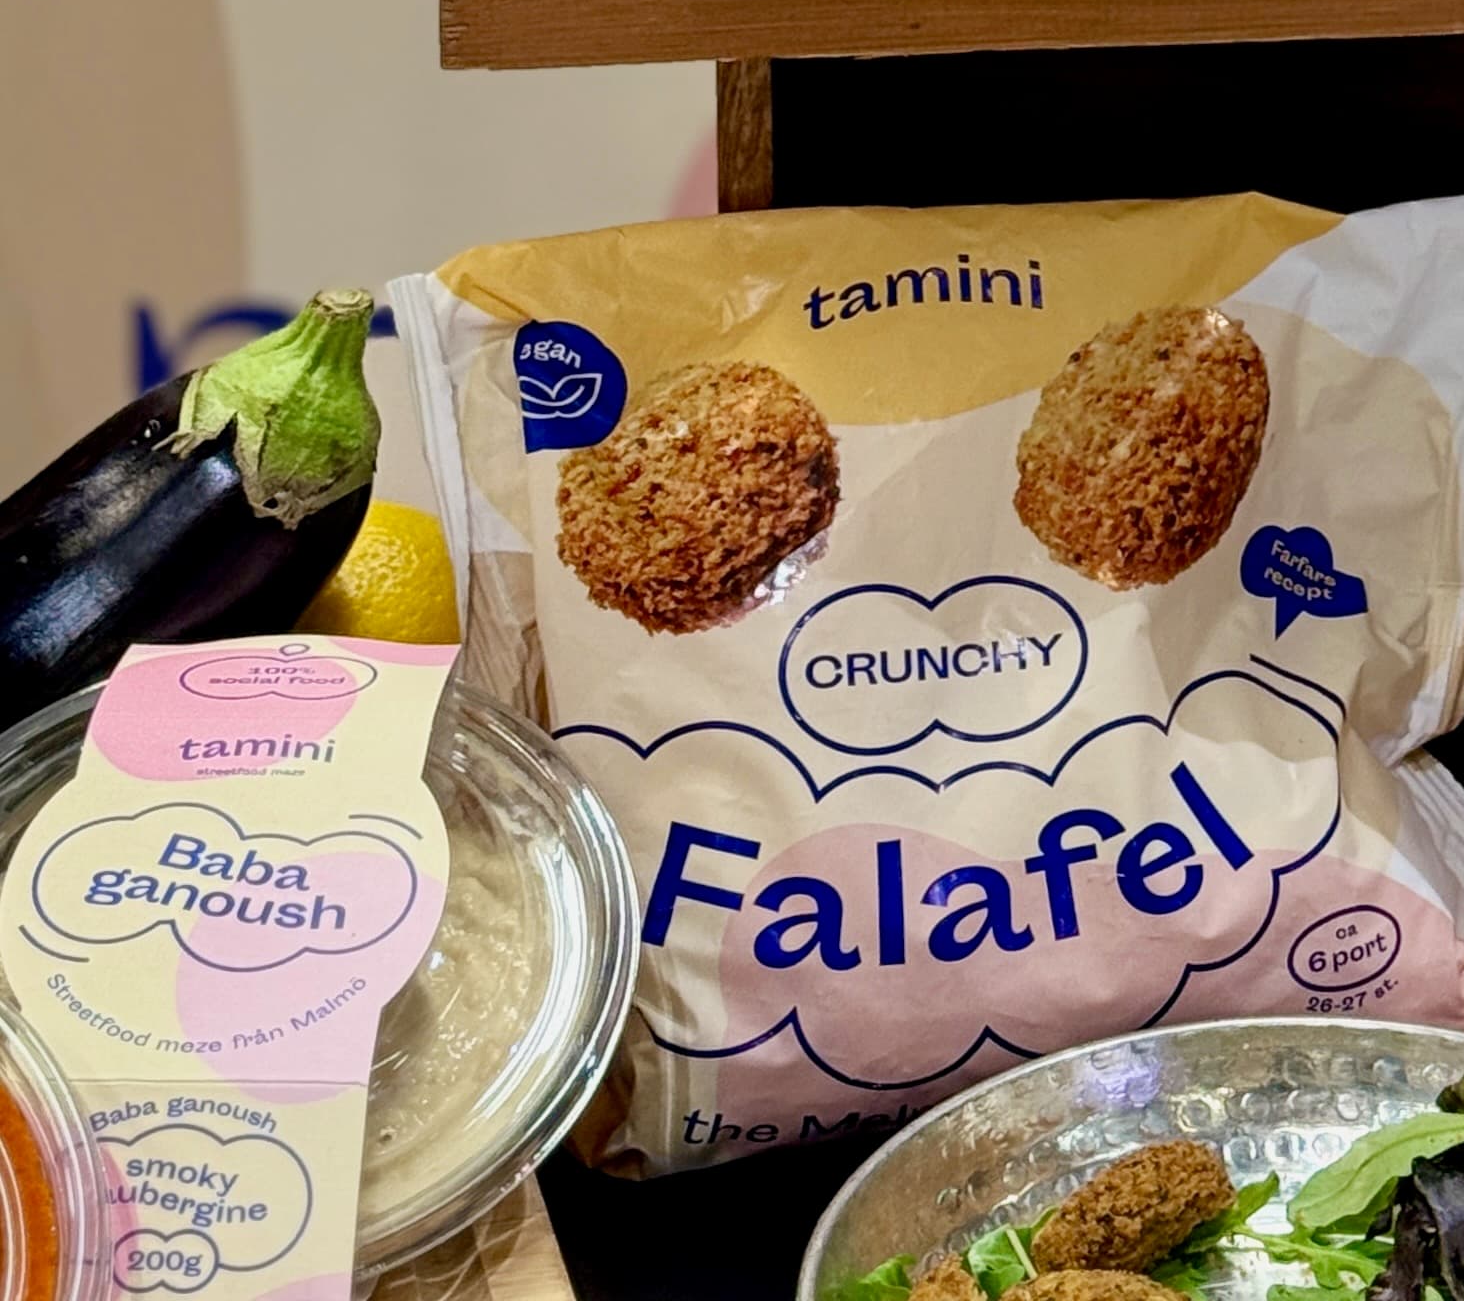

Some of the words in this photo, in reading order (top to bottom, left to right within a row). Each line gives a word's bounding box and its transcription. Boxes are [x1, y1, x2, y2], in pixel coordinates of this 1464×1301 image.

[802, 254, 1044, 330] tamini
[1270, 539, 1337, 587] Farfars
[1263, 567, 1334, 601] recept
[208, 676, 281, 685] social
[287, 676, 346, 685] food
[804, 632, 1063, 690] CRUNCHY
[180, 733, 337, 764] tamini
[157, 833, 311, 891] Baba
[640, 760, 1255, 973] Falafel
[83, 867, 347, 931] ganoush
[1335, 924, 1358, 940] ca
[1308, 951, 1327, 973] 6
[1332, 933, 1388, 973] port
[46, 973, 151, 1048] Streetfood
[156, 1036, 222, 1054] meze
[232, 1026, 285, 1052] från
[290, 976, 367, 1032] Malmö
[1306, 990, 1368, 1014] 26-27
[89, 1100, 159, 1132] Baba
[166, 1097, 278, 1133] ganoush
[683, 1108, 779, 1145] the
[125, 1157, 240, 1197] smoky
[126, 1250, 203, 1277] 200g
